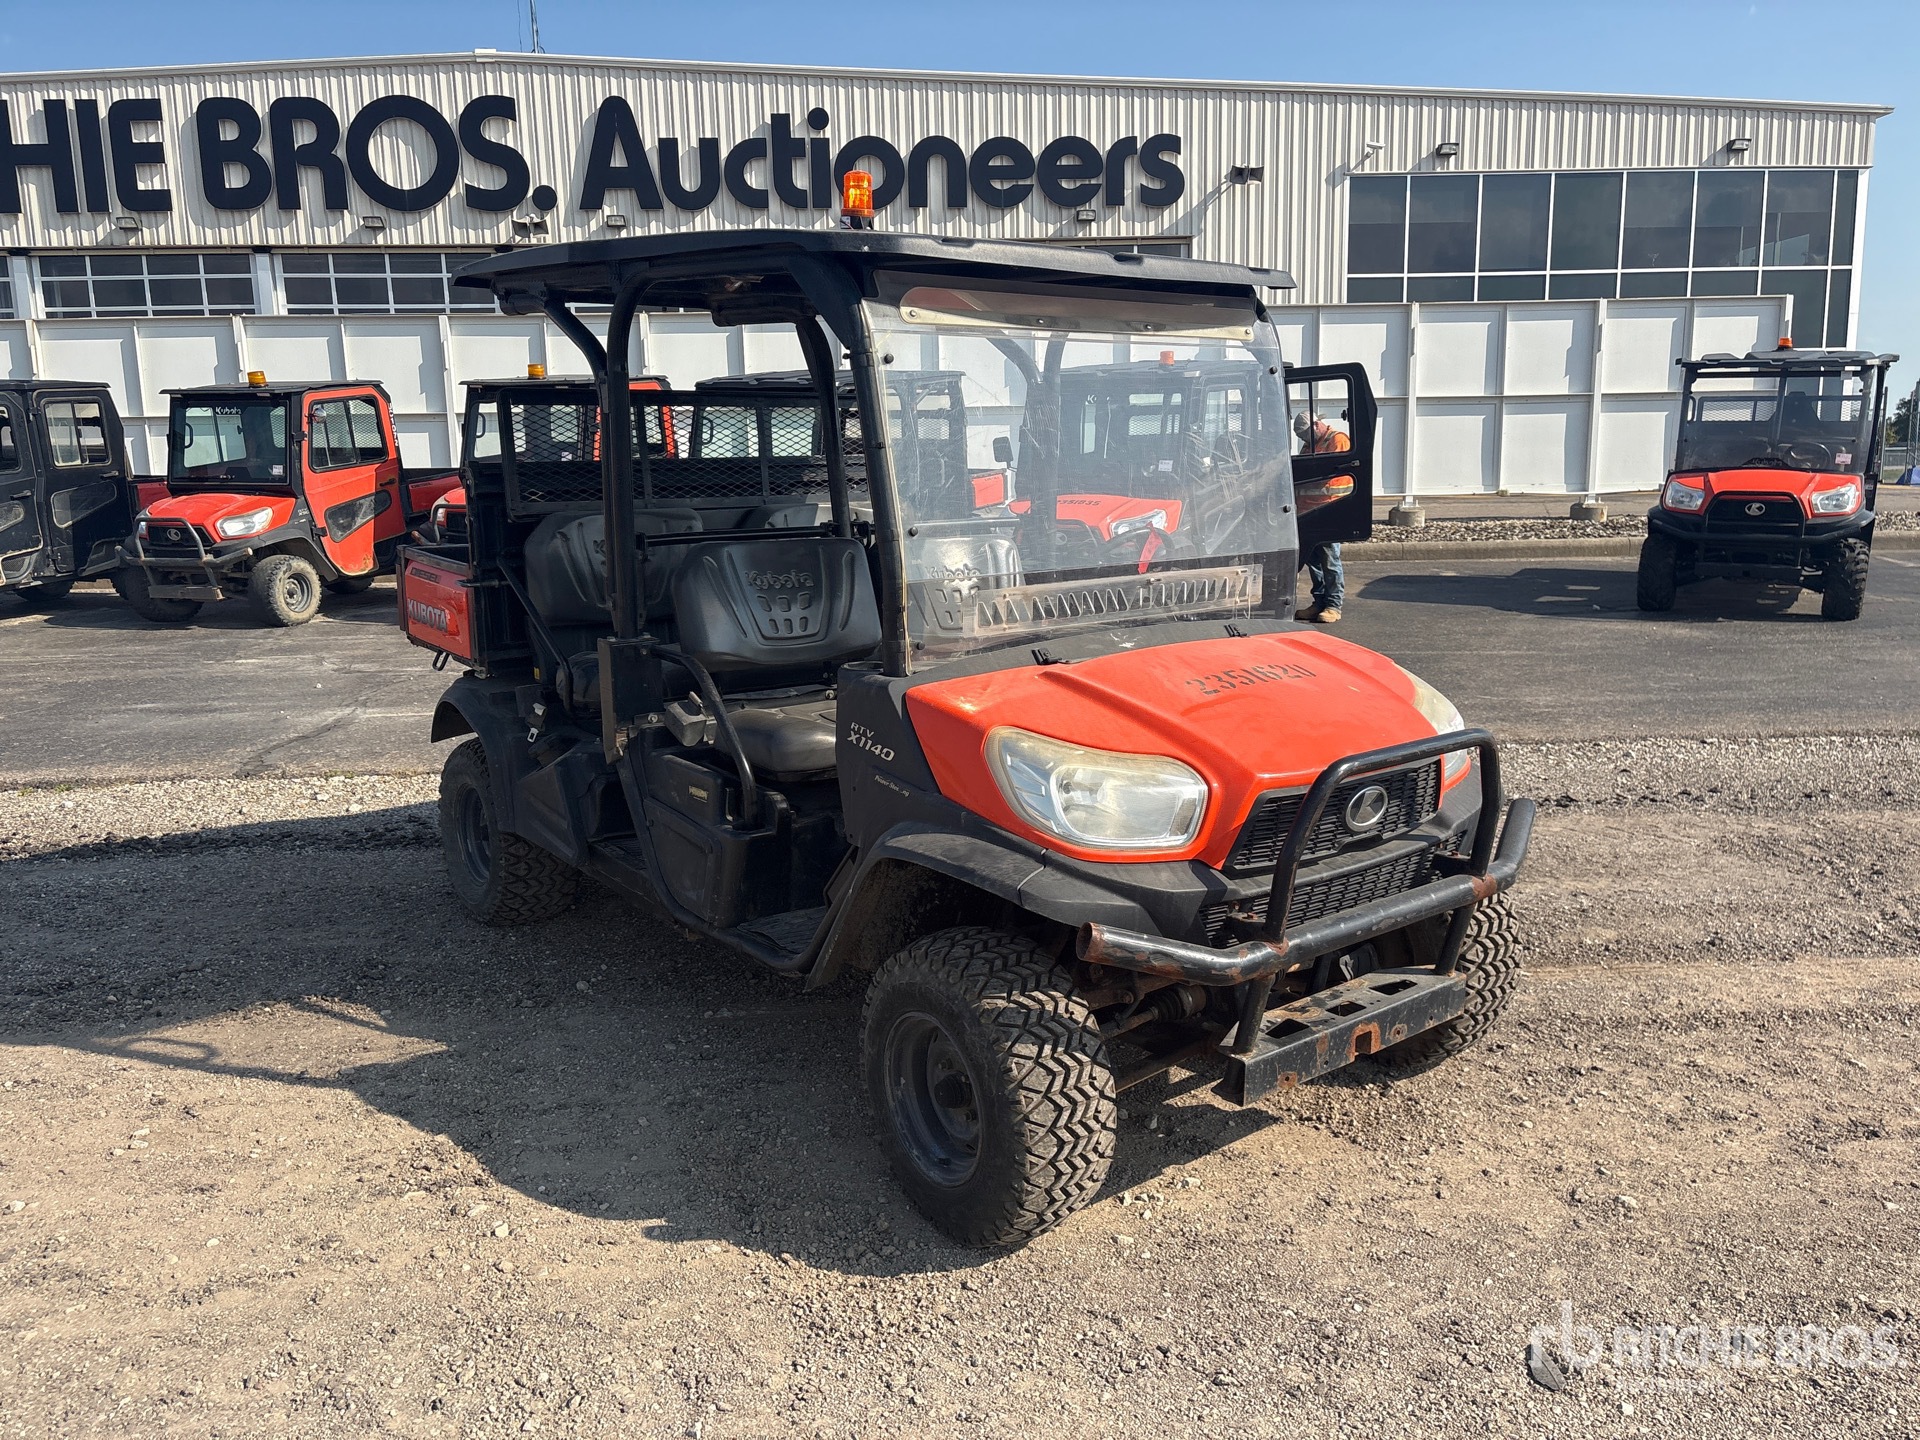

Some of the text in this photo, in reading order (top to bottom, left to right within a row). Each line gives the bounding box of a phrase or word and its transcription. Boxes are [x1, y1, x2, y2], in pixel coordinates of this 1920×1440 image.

[0, 95, 1185, 215] HIE BROS. Auctioneers
[744, 569, 815, 590] Kubota
[407, 598, 449, 633] KUBOTA
[1184, 664, 1317, 695] 2351620
[850, 721, 875, 738] RTV
[846, 730, 896, 761] X1140
